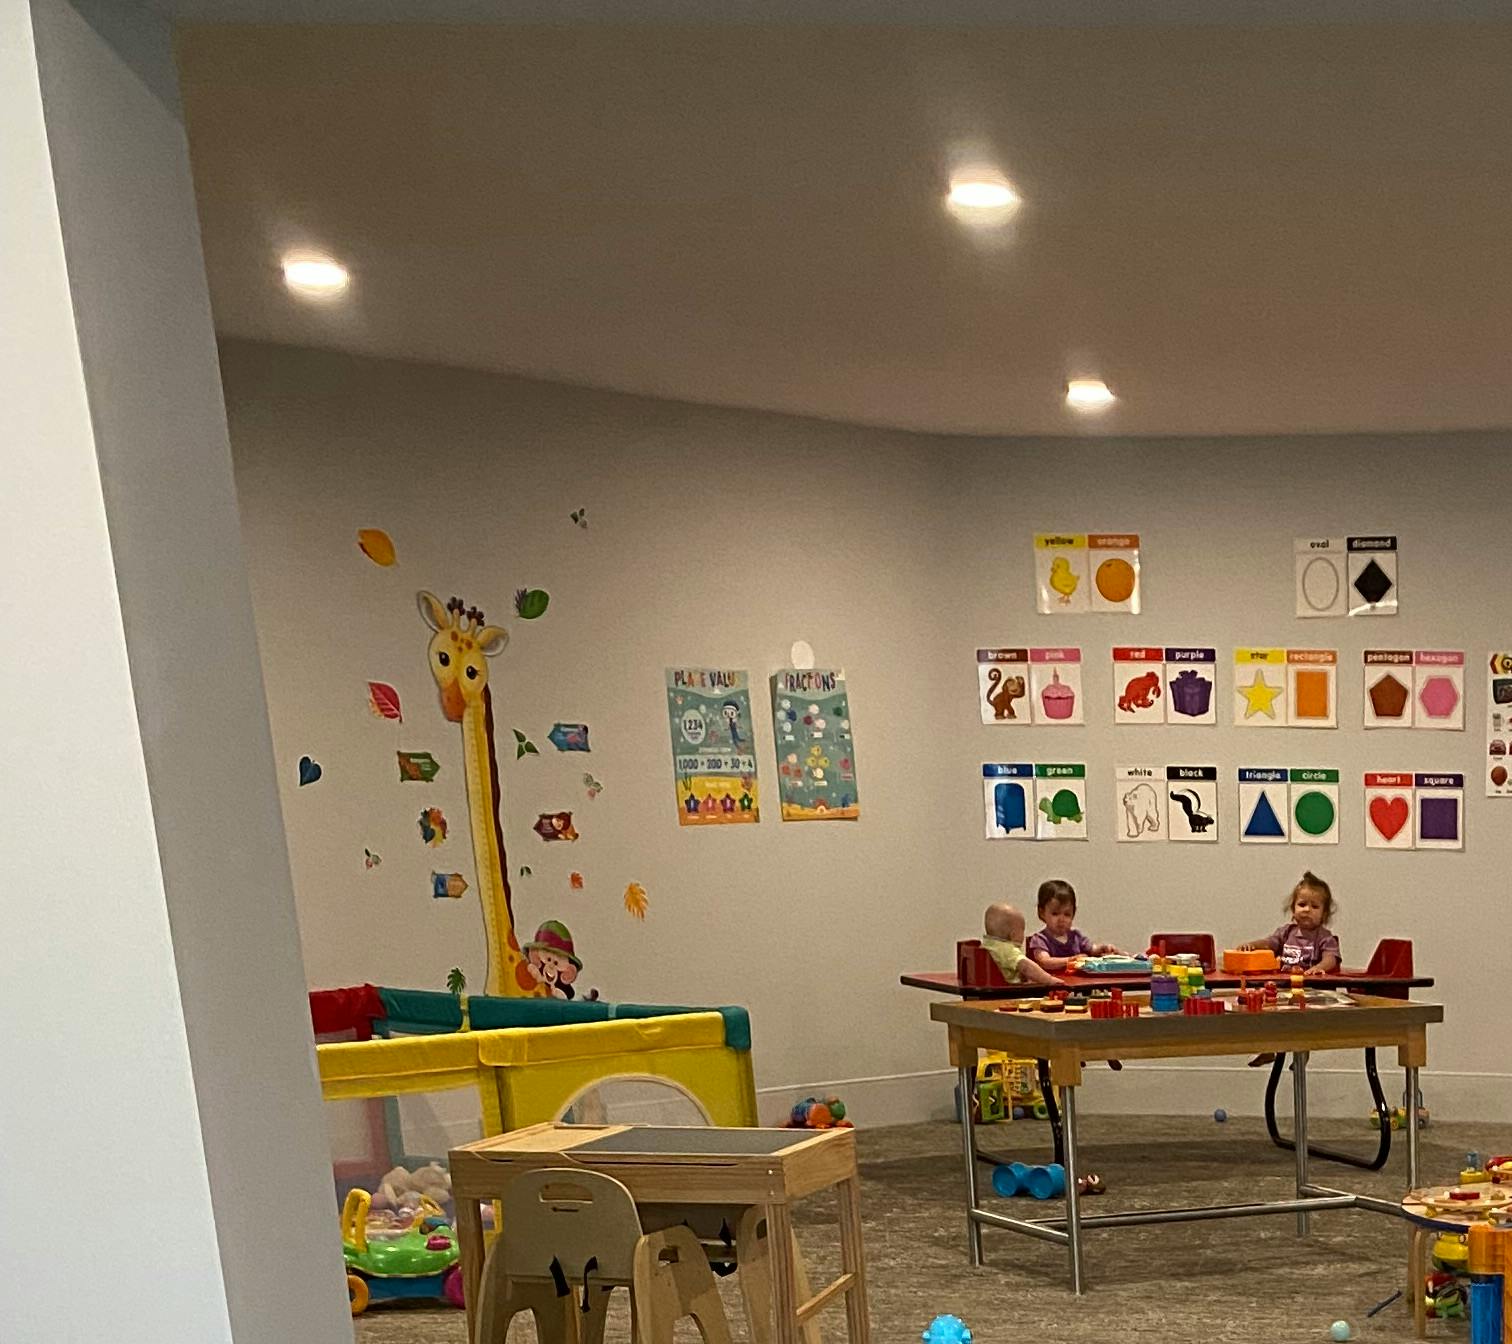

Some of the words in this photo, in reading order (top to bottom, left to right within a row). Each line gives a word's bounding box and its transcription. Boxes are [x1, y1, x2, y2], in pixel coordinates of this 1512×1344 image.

[1045, 536, 1074, 545] yellow
[1310, 539, 1329, 548] oval
[1352, 539, 1391, 548] diamond
[987, 651, 1017, 660] brown
[1045, 651, 1065, 660] pink
[1130, 651, 1146, 659] red
[1175, 650, 1204, 659] purple
[1250, 652, 1268, 660] star
[1368, 654, 1410, 662] pentagon
[1420, 652, 1458, 663] hexagon
[674, 670, 706, 687] PLAE
[997, 766, 1017, 774] blue
[1046, 767, 1073, 776] green
[1128, 768, 1152, 776] white
[1180, 769, 1203, 777] black
[1246, 771, 1281, 780] triangle
[1302, 772, 1327, 780] circle
[1376, 775, 1400, 784] heart
[1424, 777, 1454, 785] square
